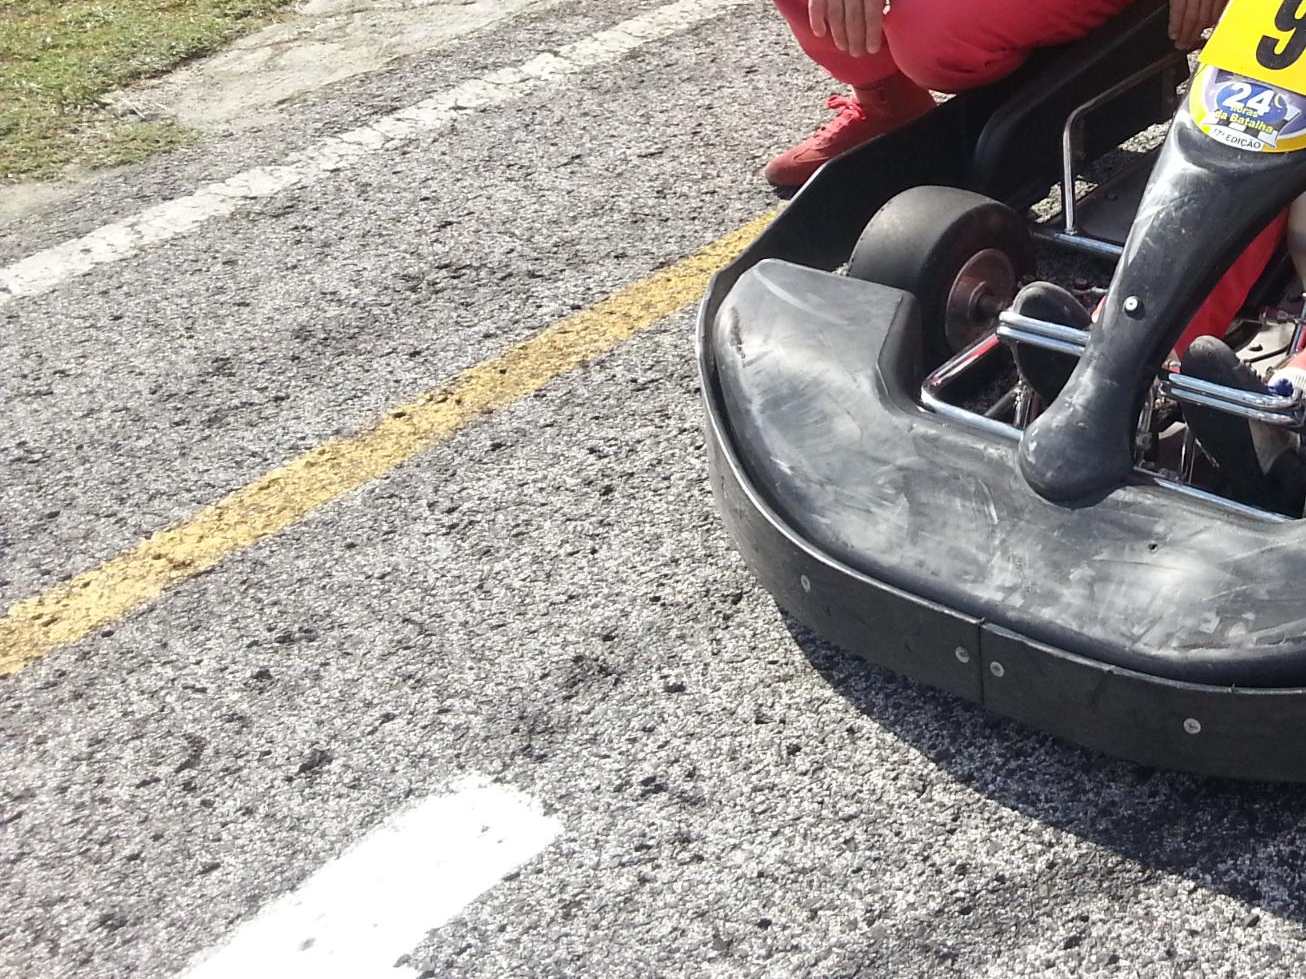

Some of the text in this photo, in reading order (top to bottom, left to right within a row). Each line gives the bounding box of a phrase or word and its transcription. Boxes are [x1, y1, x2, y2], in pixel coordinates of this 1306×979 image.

[1222, 82, 1275, 116] 24
[1230, 104, 1259, 118] horas
[1214, 109, 1274, 133] da Batalha
[1225, 134, 1261, 149] EDIÇÃO
